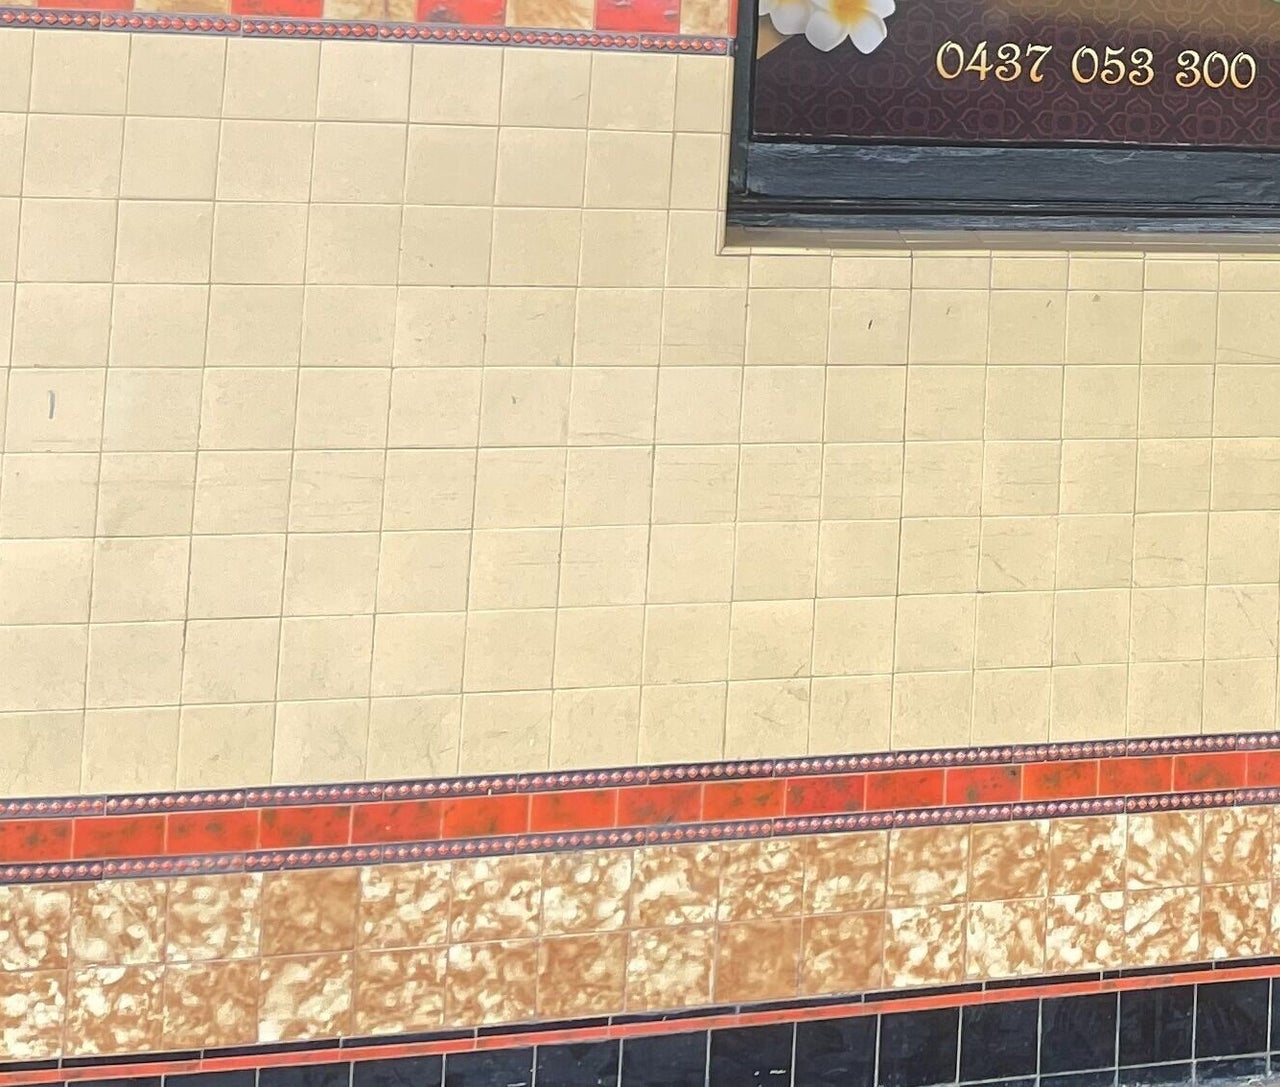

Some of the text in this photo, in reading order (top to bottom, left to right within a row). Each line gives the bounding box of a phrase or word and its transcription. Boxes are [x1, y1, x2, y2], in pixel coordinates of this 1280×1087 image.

[935, 39, 1257, 90] 0437 053 300
